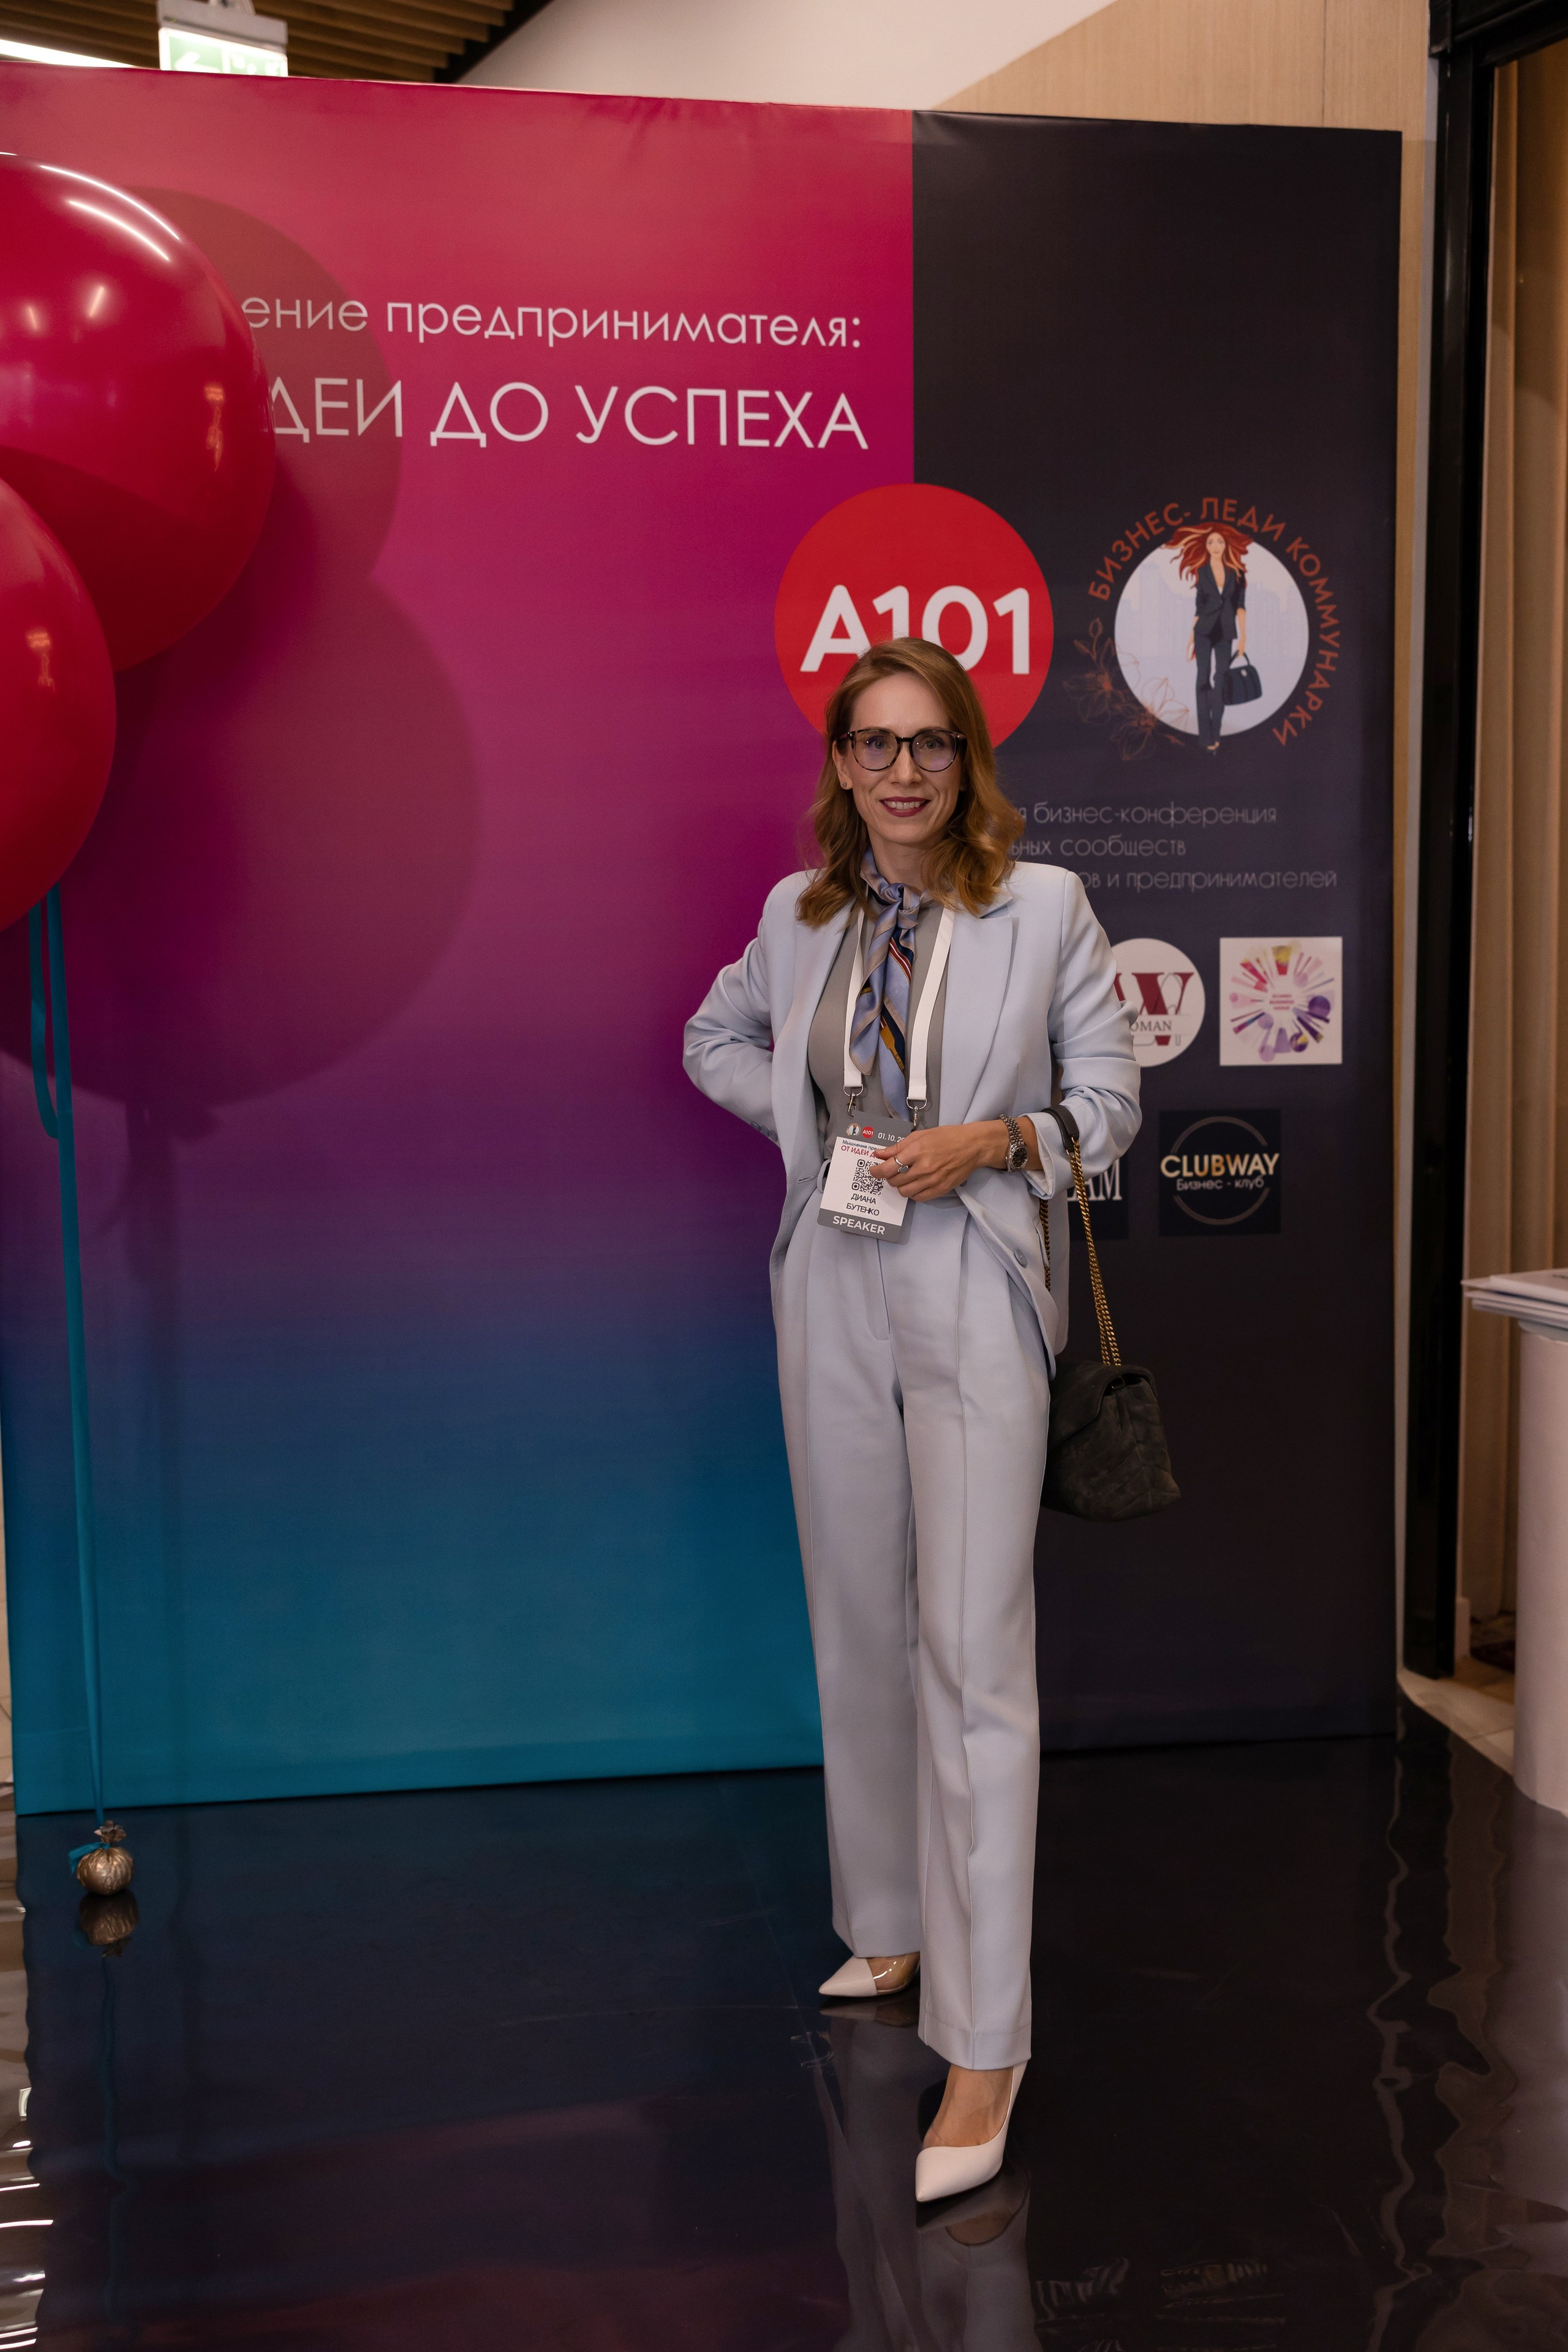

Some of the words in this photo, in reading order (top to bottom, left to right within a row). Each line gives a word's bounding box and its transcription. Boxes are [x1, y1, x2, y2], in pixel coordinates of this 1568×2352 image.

[241, 297, 368, 331] ение
[387, 302, 860, 349] предпринимателя:
[271, 377, 403, 443] ДЕИ
[430, 381, 549, 448] ДО
[575, 384, 869, 450] УСПЕХА
[1200, 497, 1286, 541] ЛЕДИ
[1272, 537, 1340, 746] КОММУНАРКИ
[1033, 801, 1276, 827] бизнес-конференция
[1011, 840, 1052, 856] ьных
[1060, 834, 1186, 856] сообществ
[1107, 873, 1120, 887] и
[1126, 870, 1338, 892] предпринимателей
[1131, 1020, 1172, 1031] OMAN
[842, 1140, 867, 1148] Мышление
[851, 1147, 869, 1156] ИДЕИ
[1161, 1153, 1280, 1178] CLUBWAY
[1176, 1178, 1223, 1191] Бизнес
[1234, 1175, 1264, 1190] клуб
[846, 1203, 880, 1216] БУТЕНКО
[851, 1193, 876, 1205] ДИАНА
[832, 1215, 886, 1235] SPEAKER
